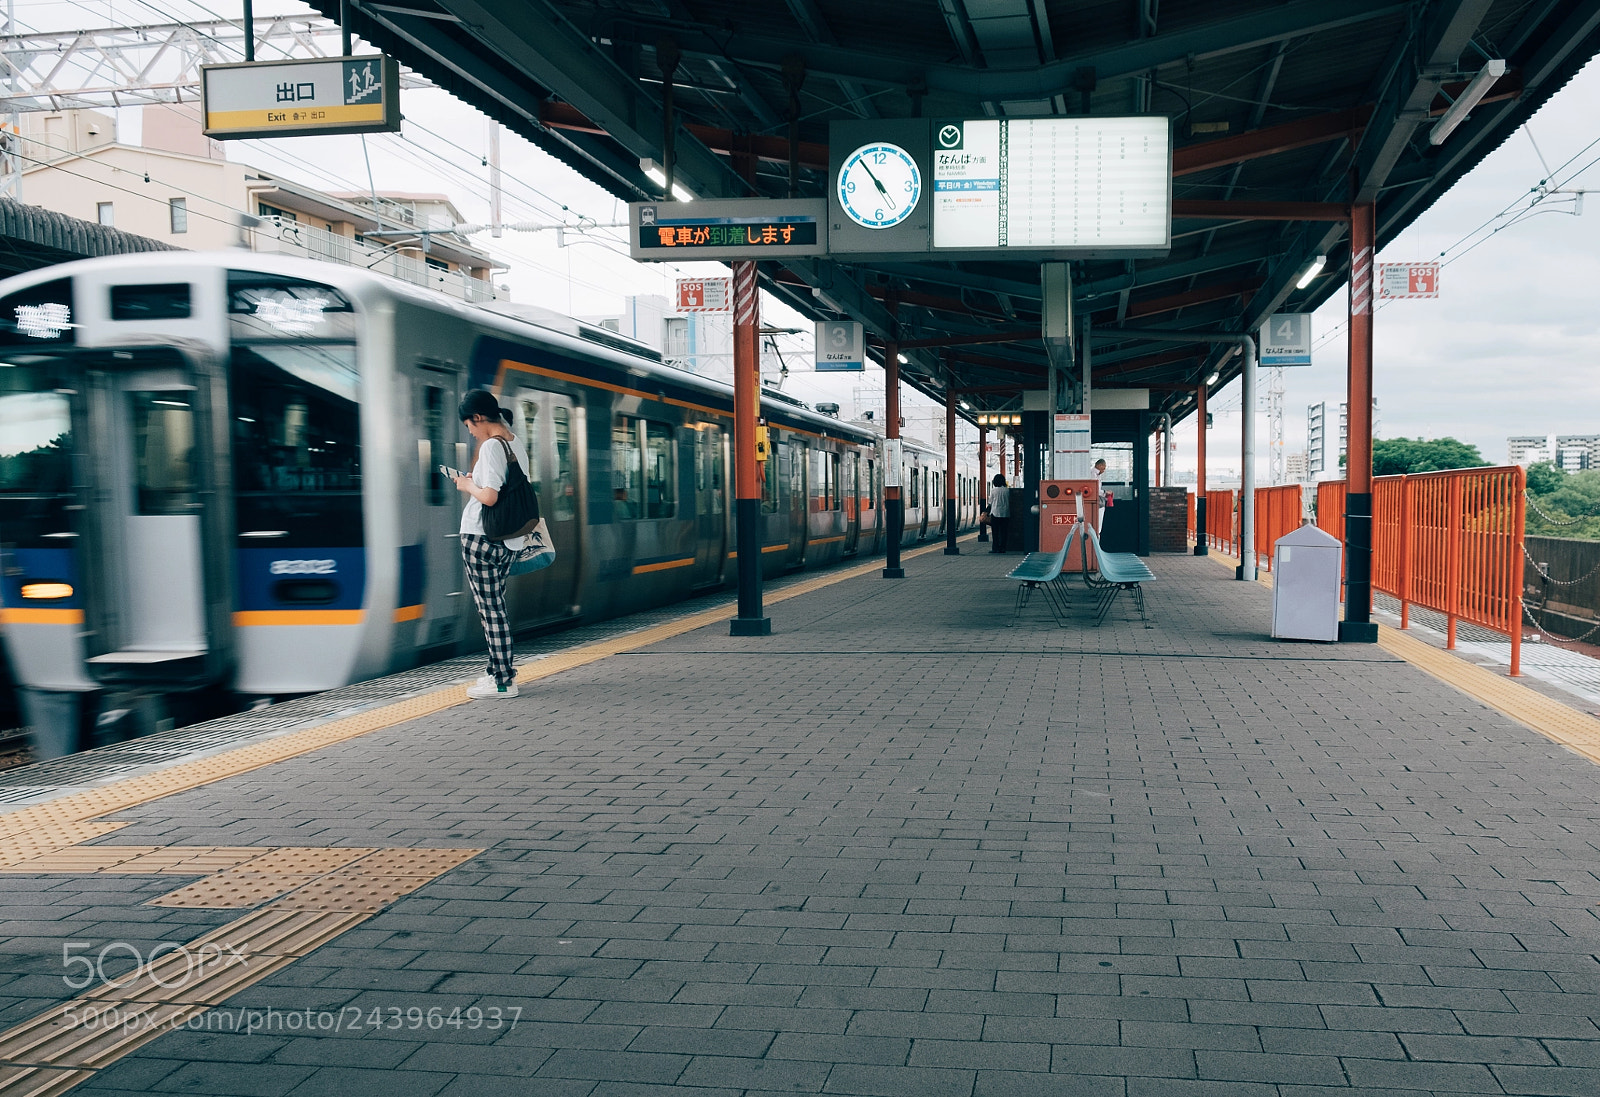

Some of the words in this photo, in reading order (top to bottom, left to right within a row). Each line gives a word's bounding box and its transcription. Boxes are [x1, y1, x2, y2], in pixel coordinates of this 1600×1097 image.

[277, 82, 315, 102] 出口
[268, 112, 286, 122] Exit
[293, 112, 307, 120] 출구
[873, 153, 887, 165] 12
[939, 154, 987, 164] なんば方面
[847, 182, 856, 194] 9
[904, 181, 913, 192] 3
[875, 209, 884, 220] 6
[658, 225, 795, 246] 電車が到着します
[1276, 319, 1294, 340] 4
[832, 327, 847, 347] 3
